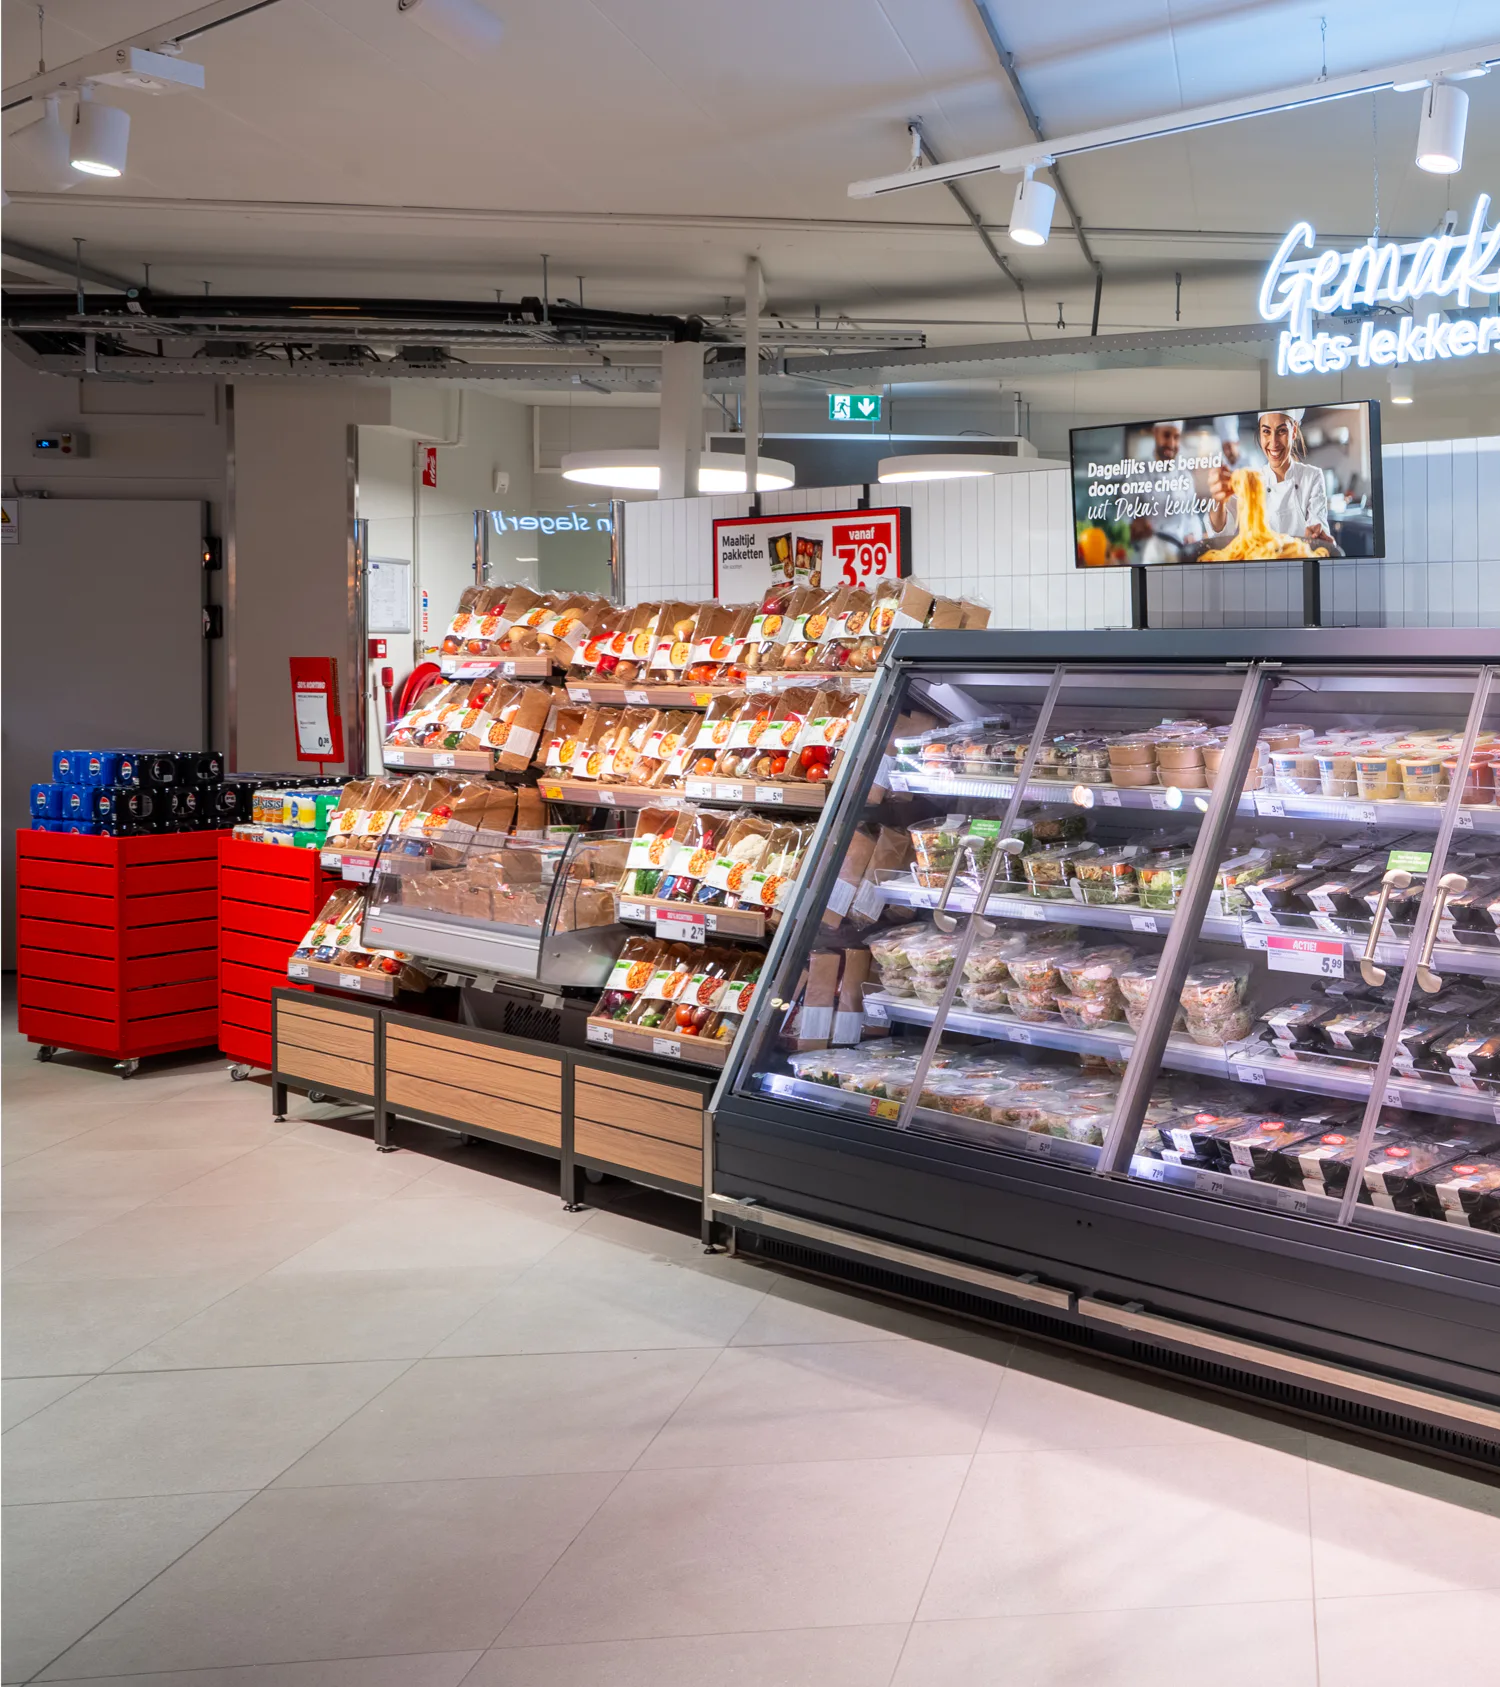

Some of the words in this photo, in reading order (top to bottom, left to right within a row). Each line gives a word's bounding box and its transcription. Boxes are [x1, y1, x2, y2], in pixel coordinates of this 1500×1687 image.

[1088, 459, 1145, 481] Dagelijks
[1148, 458, 1176, 473] vers
[1177, 452, 1222, 471] bereid
[1088, 480, 1120, 497] door
[1121, 480, 1153, 494] onze
[1154, 476, 1190, 493] chefs
[1088, 500, 1110, 520] uit
[1115, 496, 1160, 522] Deka's
[1164, 494, 1221, 516] keuken
[722, 534, 756, 547] Maaltijd
[849, 526, 876, 540] vanaf
[722, 549, 764, 563] pakketten
[1292, 940, 1317, 952] ACTIE!
[1321, 957, 1342, 975] 5.99
